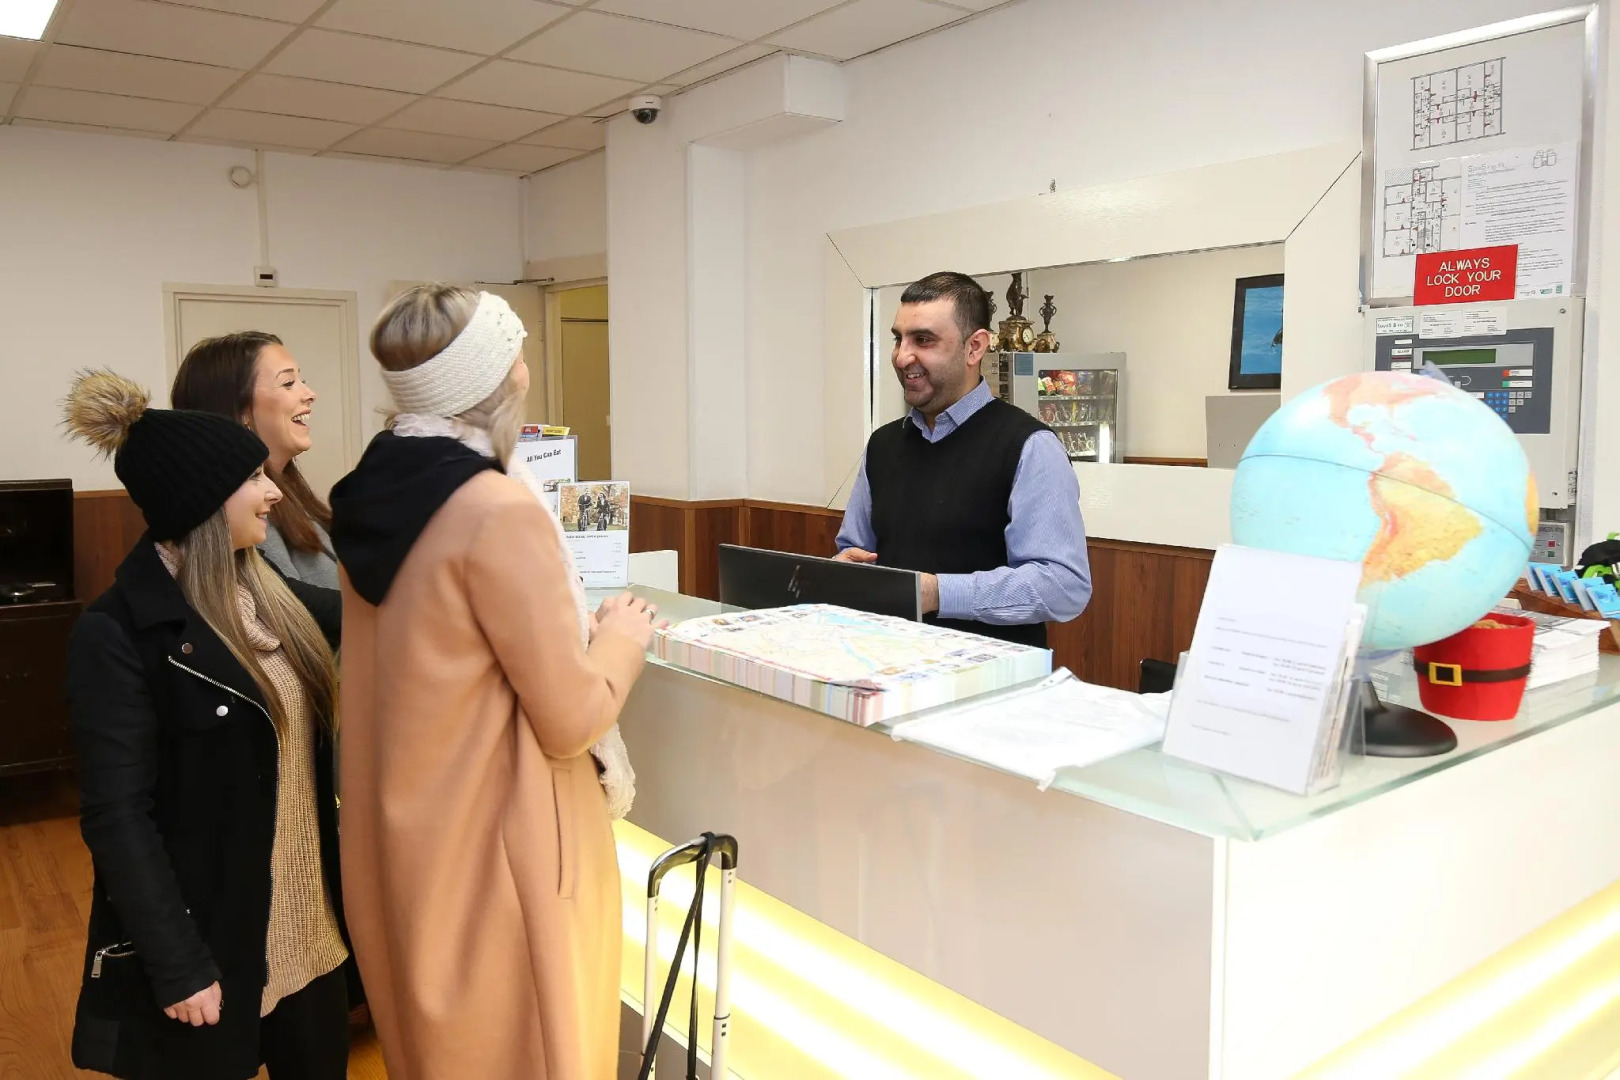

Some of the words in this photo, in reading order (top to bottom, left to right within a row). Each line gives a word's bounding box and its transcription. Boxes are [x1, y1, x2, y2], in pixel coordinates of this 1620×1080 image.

[1438, 257, 1490, 272] ALWAYS
[1427, 273, 1460, 286] LOCK
[1467, 269, 1502, 282] YOUR
[1445, 284, 1481, 298] DOOR
[526, 455, 534, 463] All
[543, 451, 552, 459] Can
